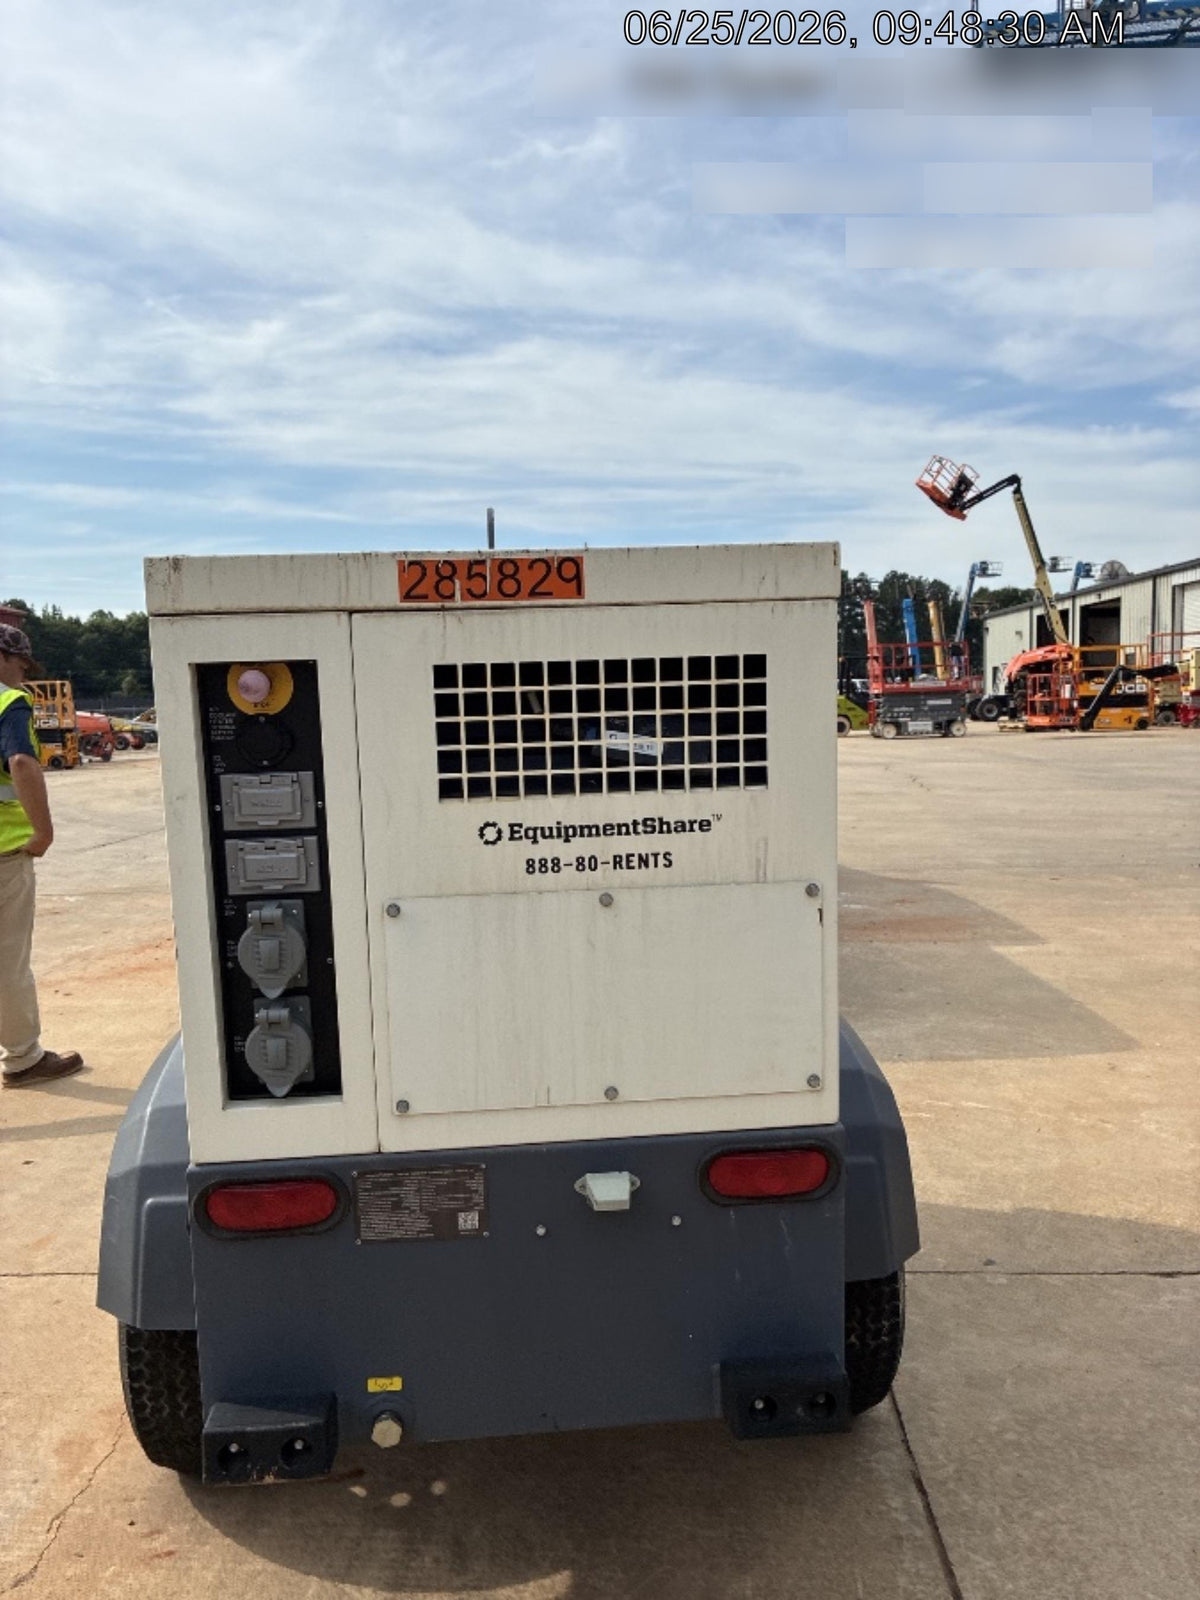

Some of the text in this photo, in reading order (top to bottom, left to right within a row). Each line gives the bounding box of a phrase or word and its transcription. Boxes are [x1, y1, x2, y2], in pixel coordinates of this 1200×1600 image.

[403, 556, 582, 600] 285829
[508, 816, 712, 845] EquipmentShare
[525, 851, 674, 875] 888-80-RENTS
